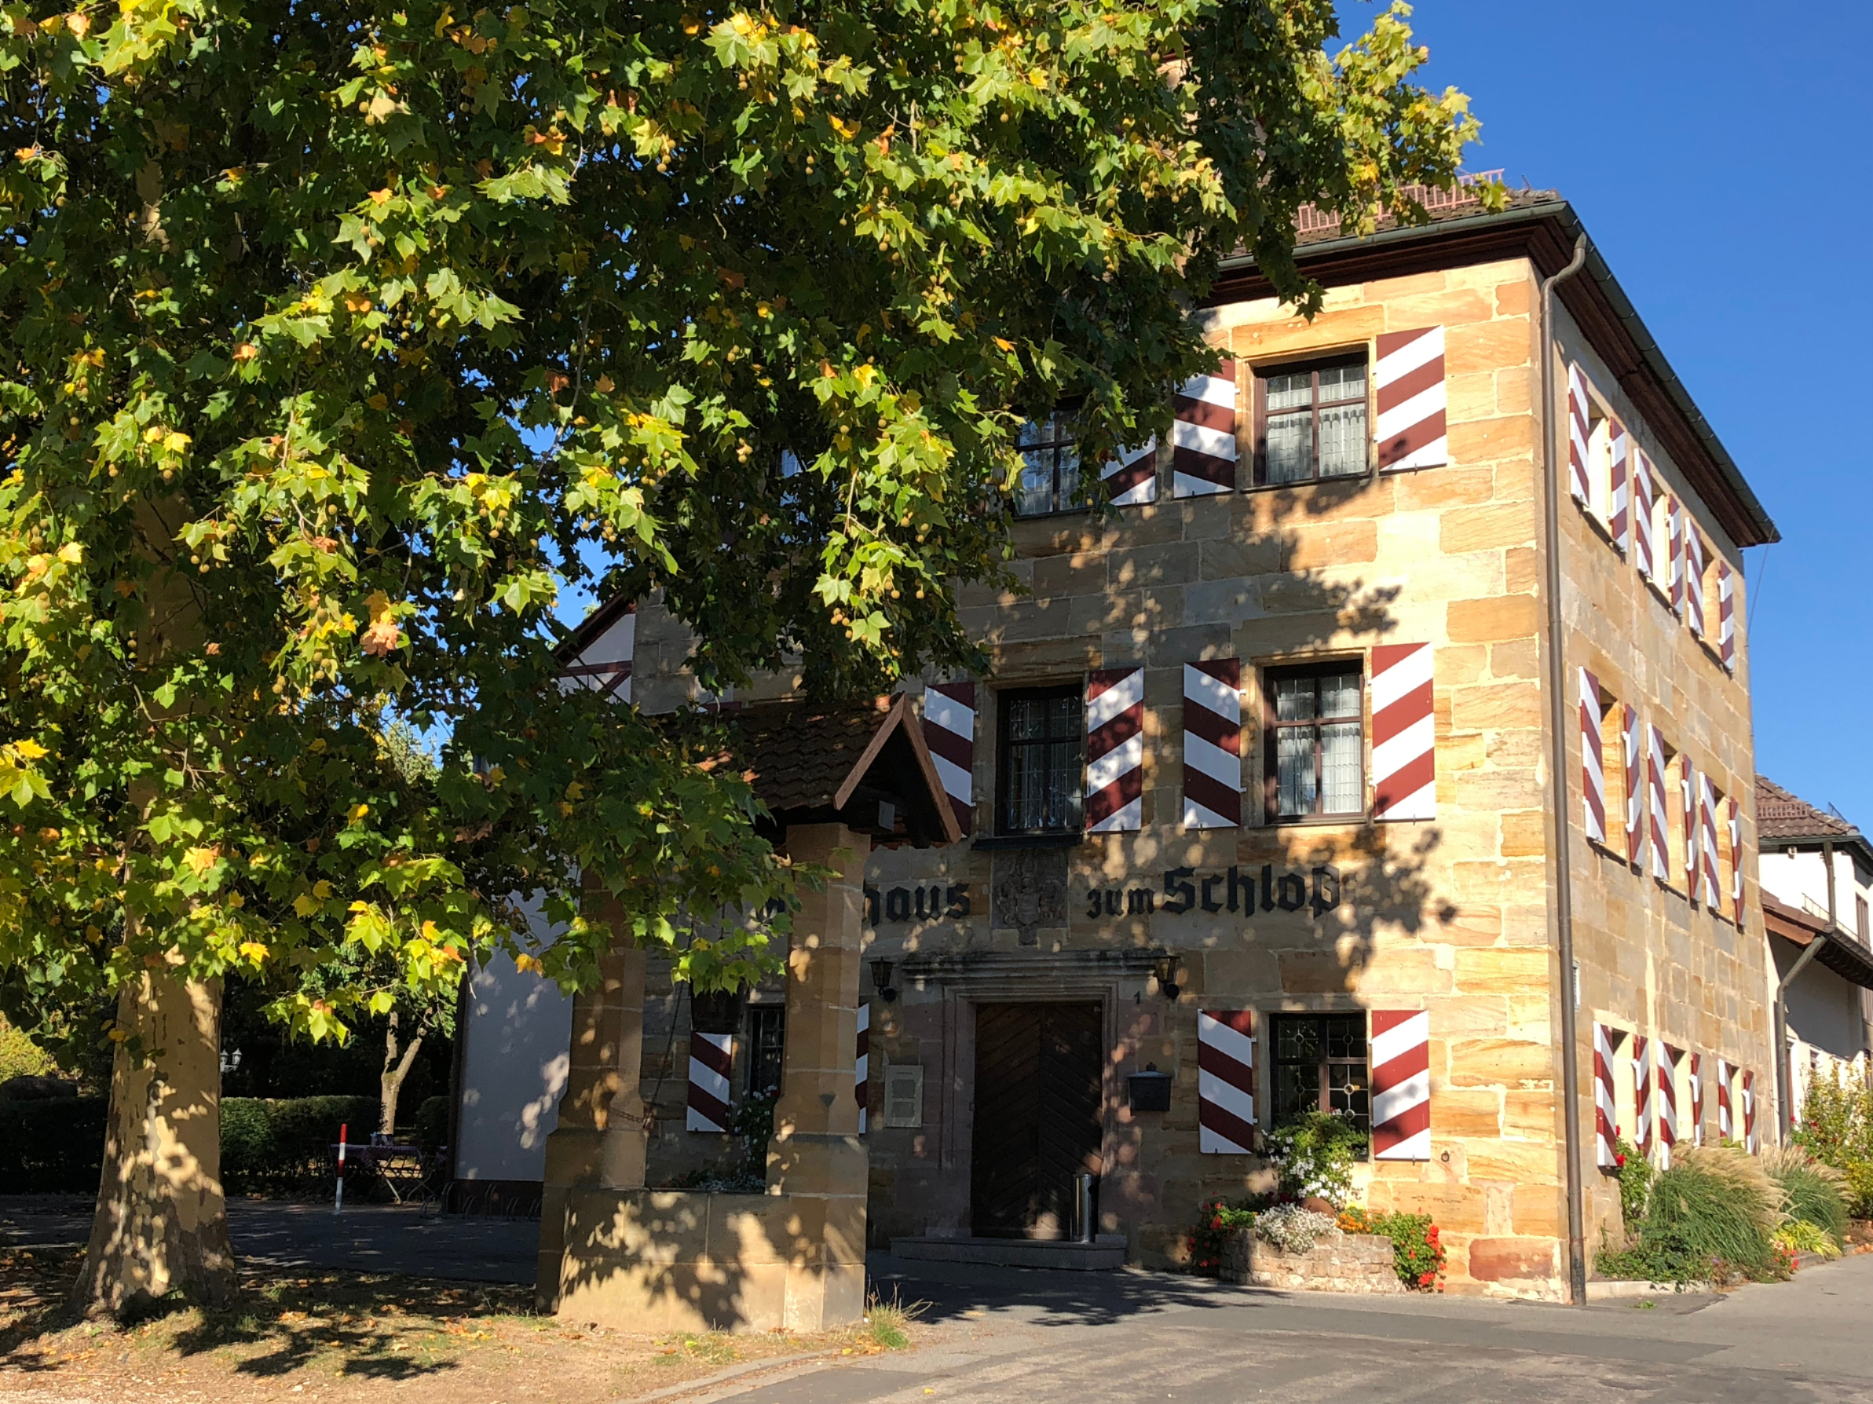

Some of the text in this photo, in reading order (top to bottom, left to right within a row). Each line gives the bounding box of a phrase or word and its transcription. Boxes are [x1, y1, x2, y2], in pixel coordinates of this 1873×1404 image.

[862, 863, 1341, 927] haus zum Schloß
[1133, 990, 1141, 1005] 1
